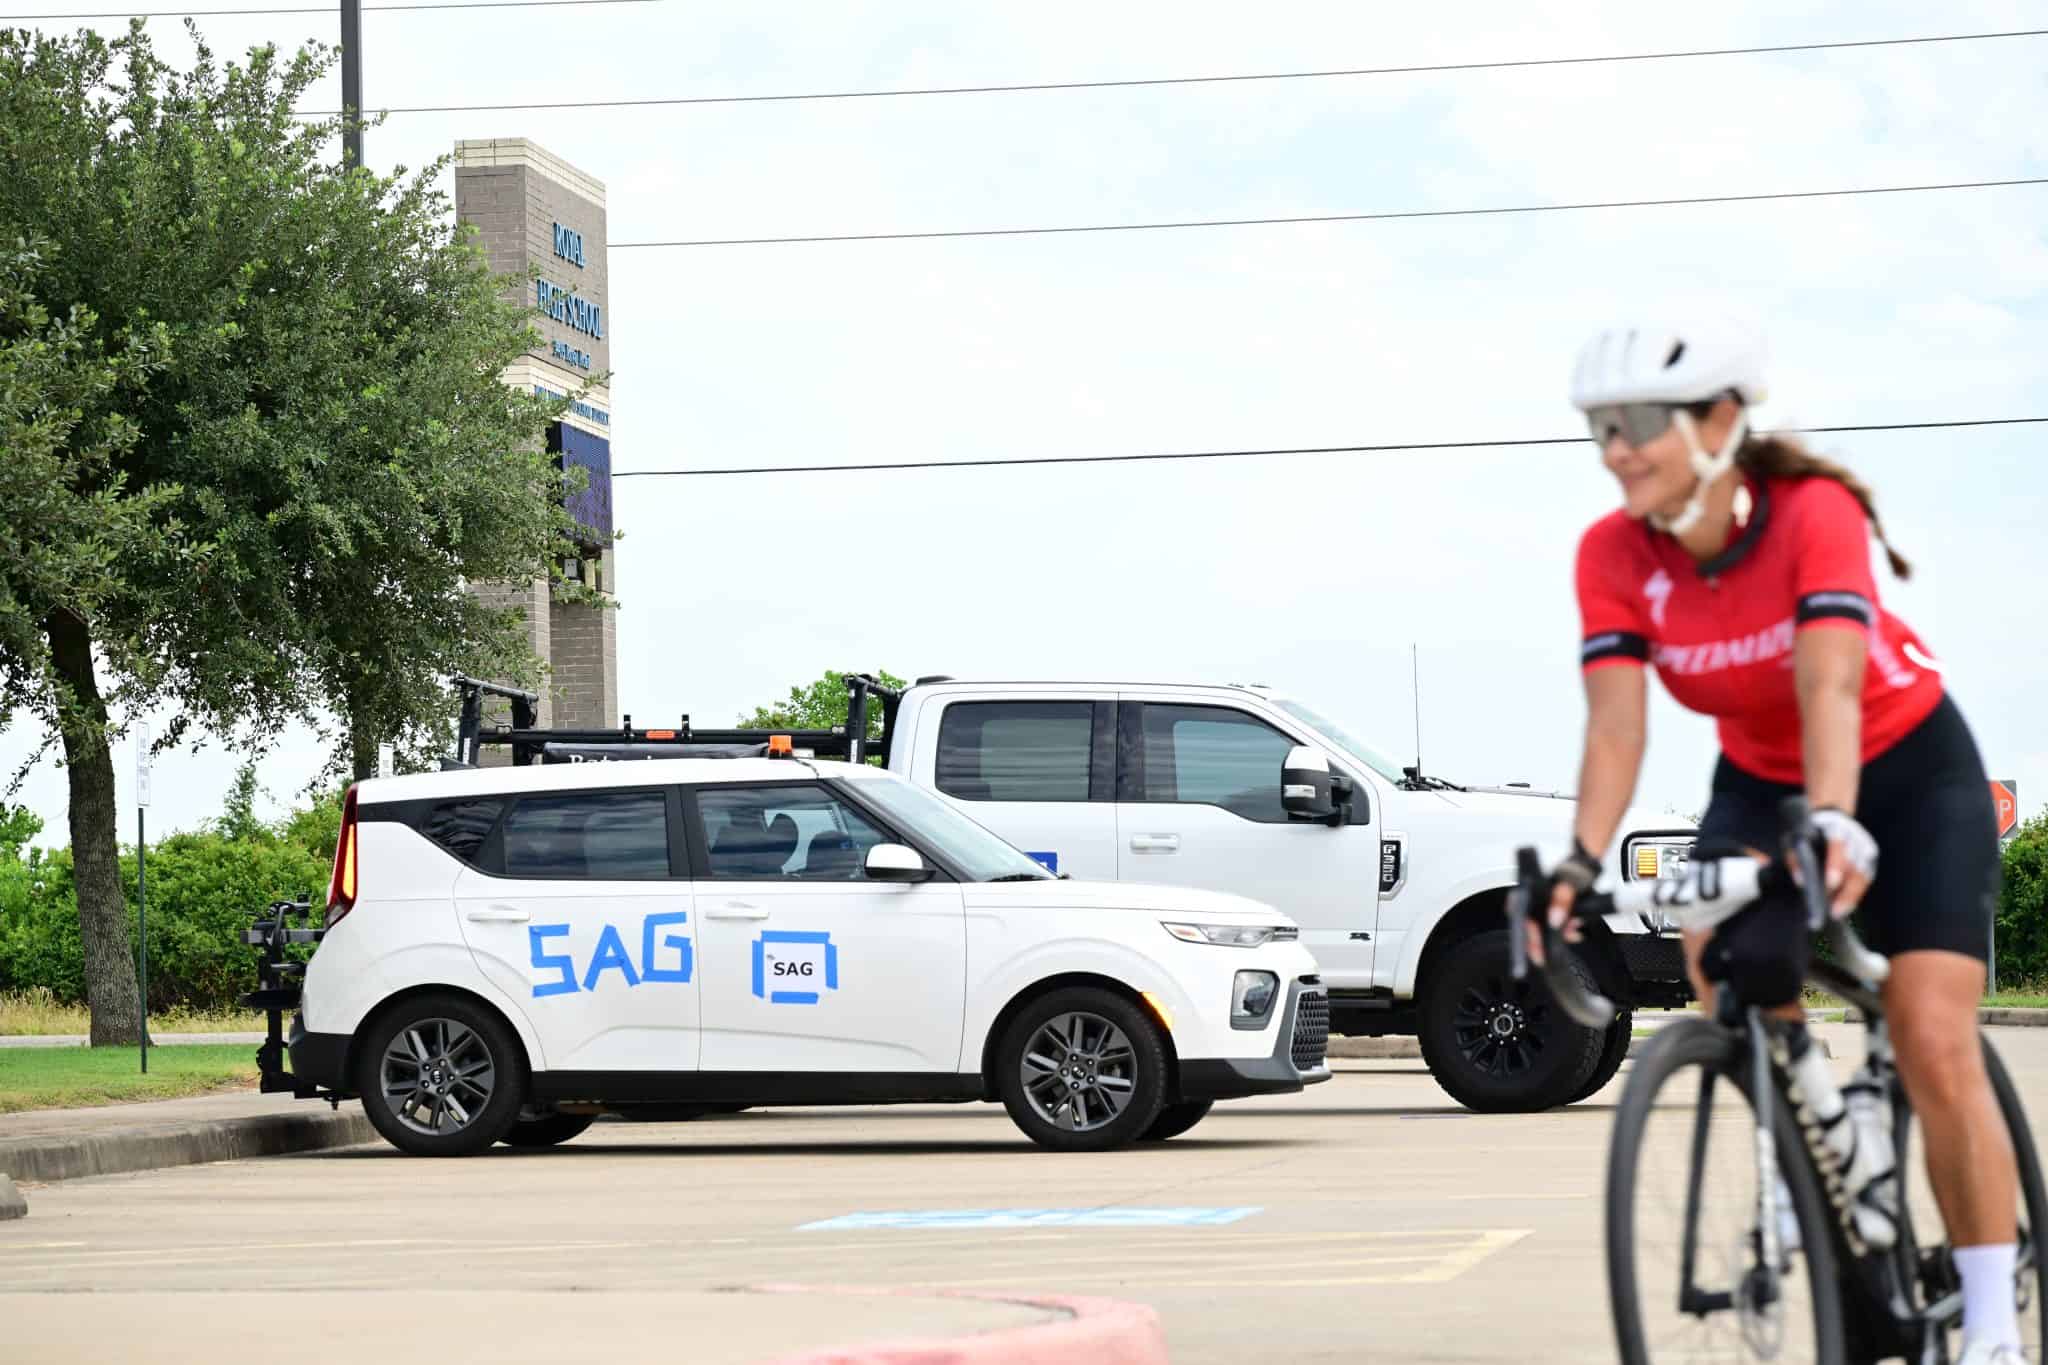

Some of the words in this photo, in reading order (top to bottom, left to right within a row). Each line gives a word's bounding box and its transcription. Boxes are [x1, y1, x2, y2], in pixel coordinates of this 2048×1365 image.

[553, 223, 585, 269] ROYAL
[537, 279, 565, 323] HIGH
[565, 293, 603, 340] SCHOOL
[528, 911, 692, 998] SAG
[773, 961, 813, 976] SAG
